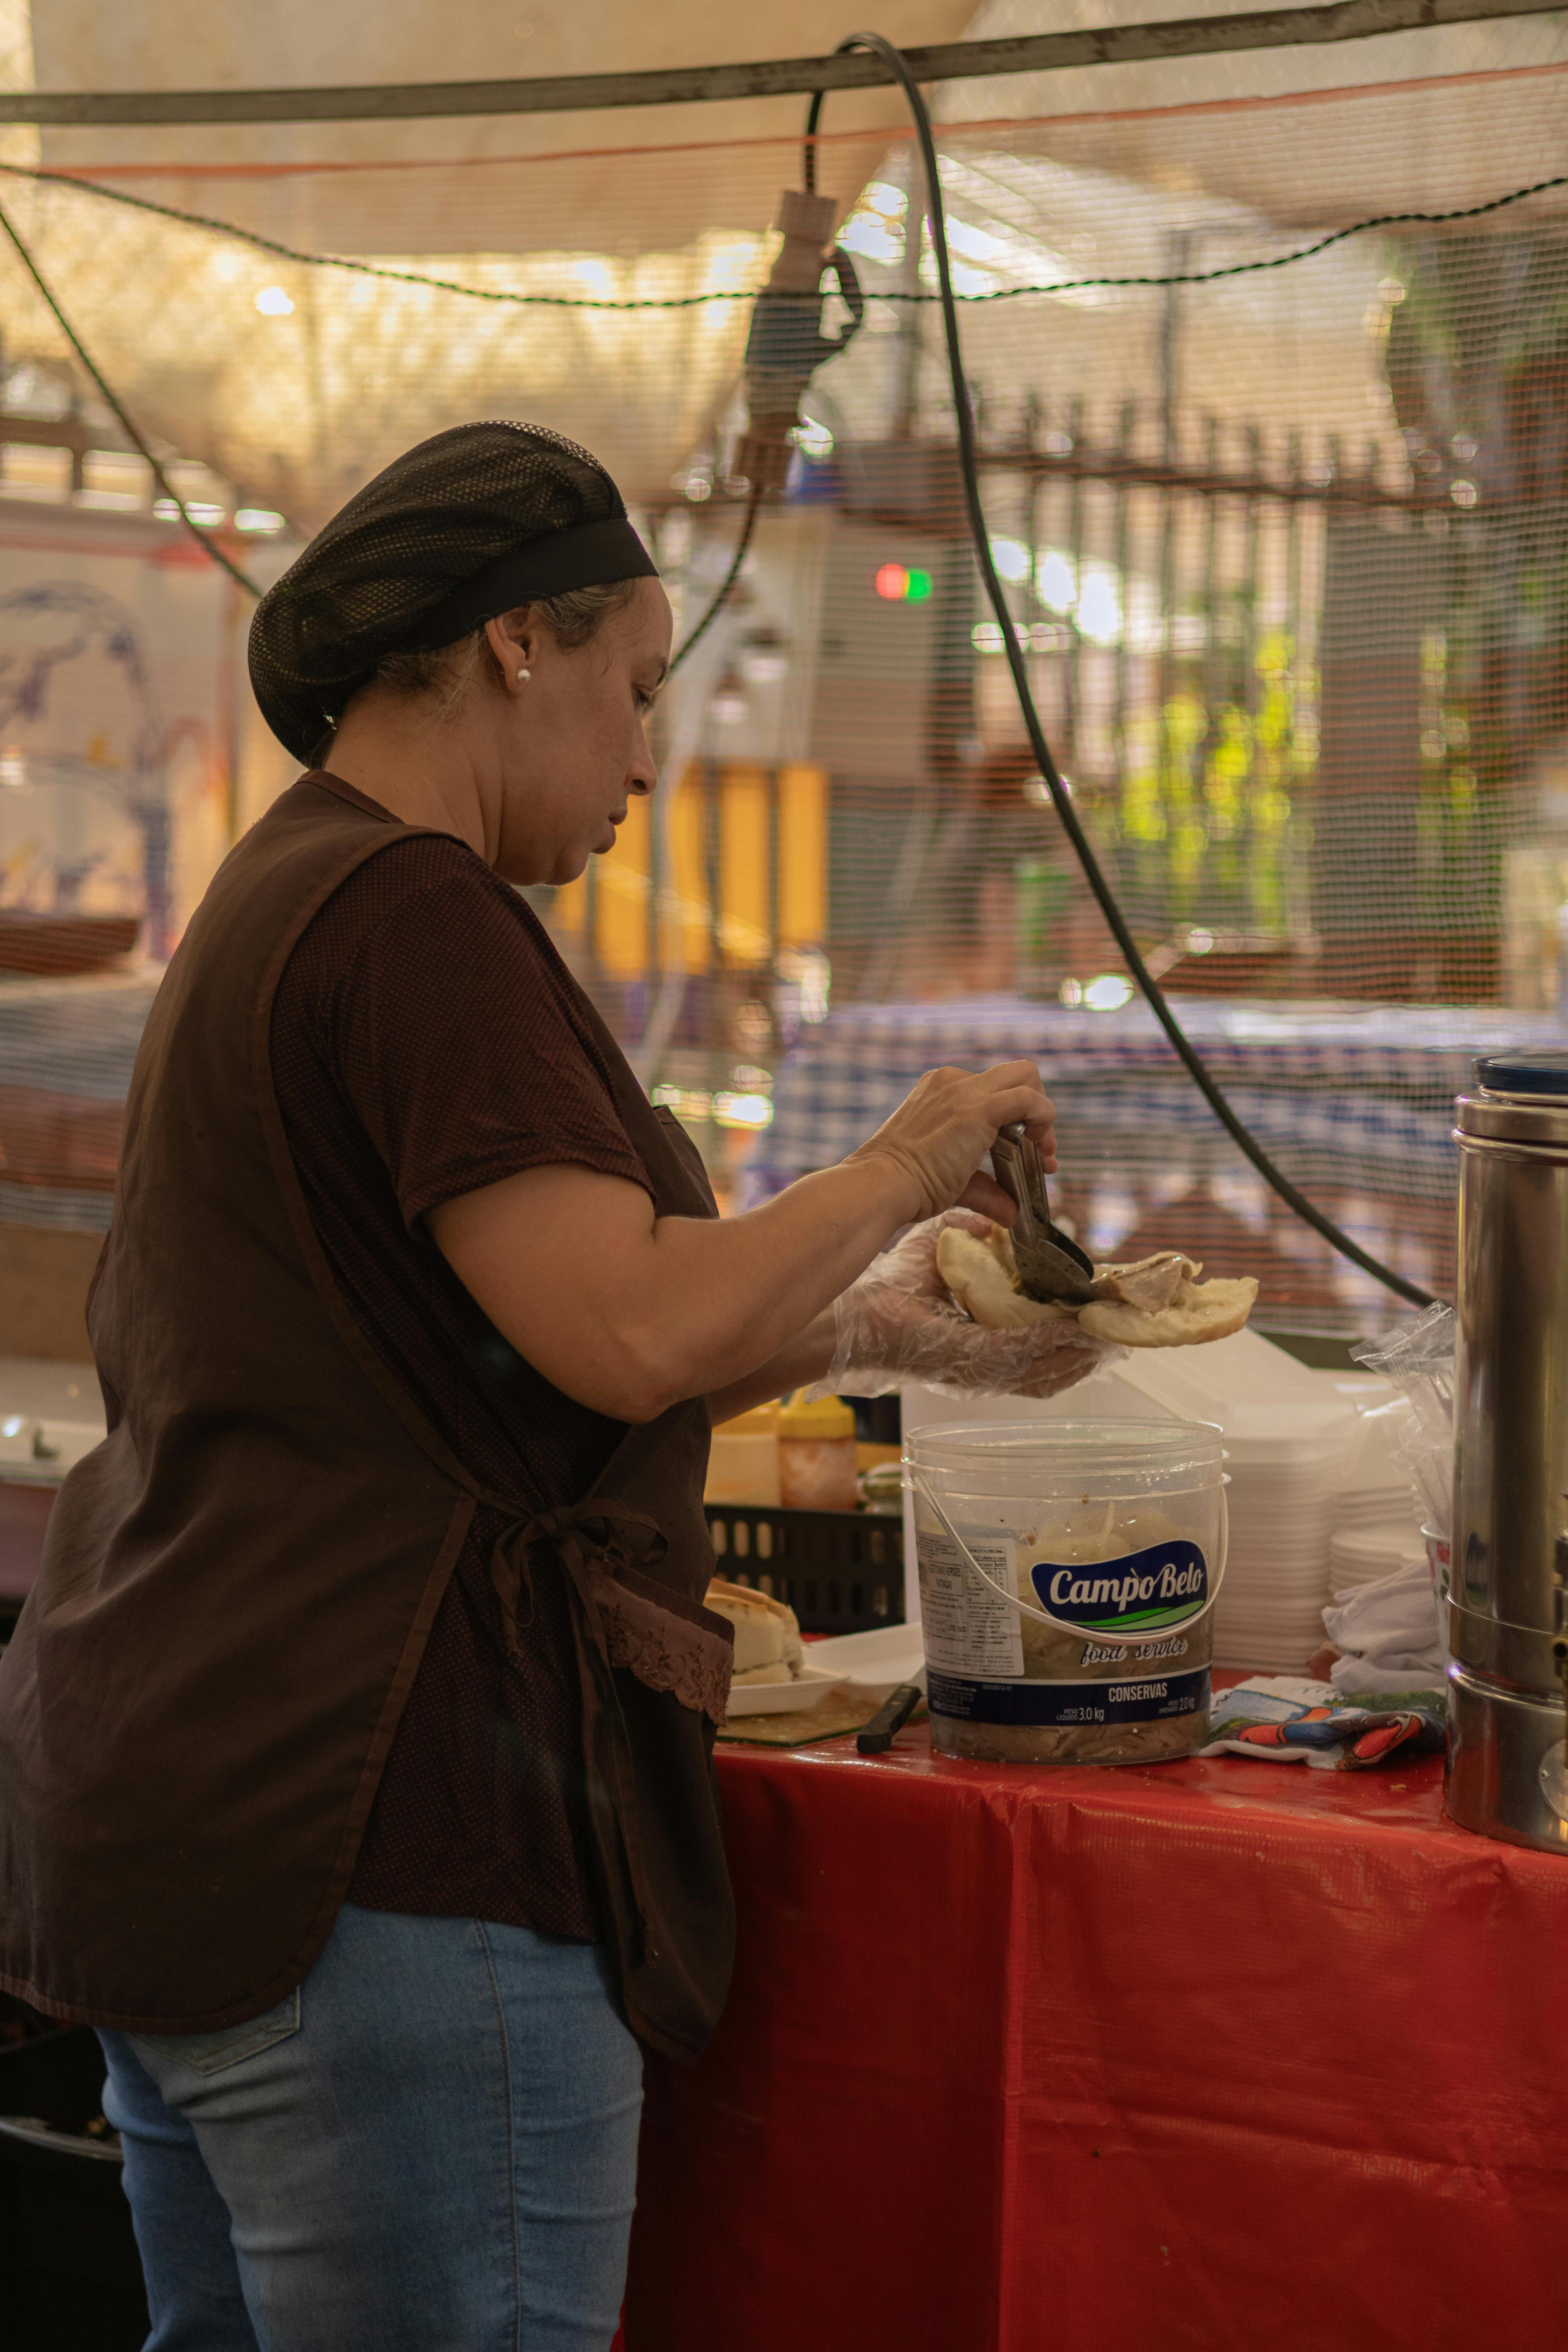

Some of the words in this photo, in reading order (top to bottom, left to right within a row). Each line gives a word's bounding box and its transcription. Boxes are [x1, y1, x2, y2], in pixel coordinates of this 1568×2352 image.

[1050, 1570, 1156, 1612] Campo
[1159, 1562, 1204, 1598] Belo
[1080, 1642, 1128, 1667] food
[1135, 1636, 1189, 1661] service
[1109, 1682, 1167, 1702] CONSERVAS
[1188, 1697, 1194, 1710] kg
[1079, 1707, 1092, 1721] 3,0
[1095, 1707, 1104, 1721] kg
